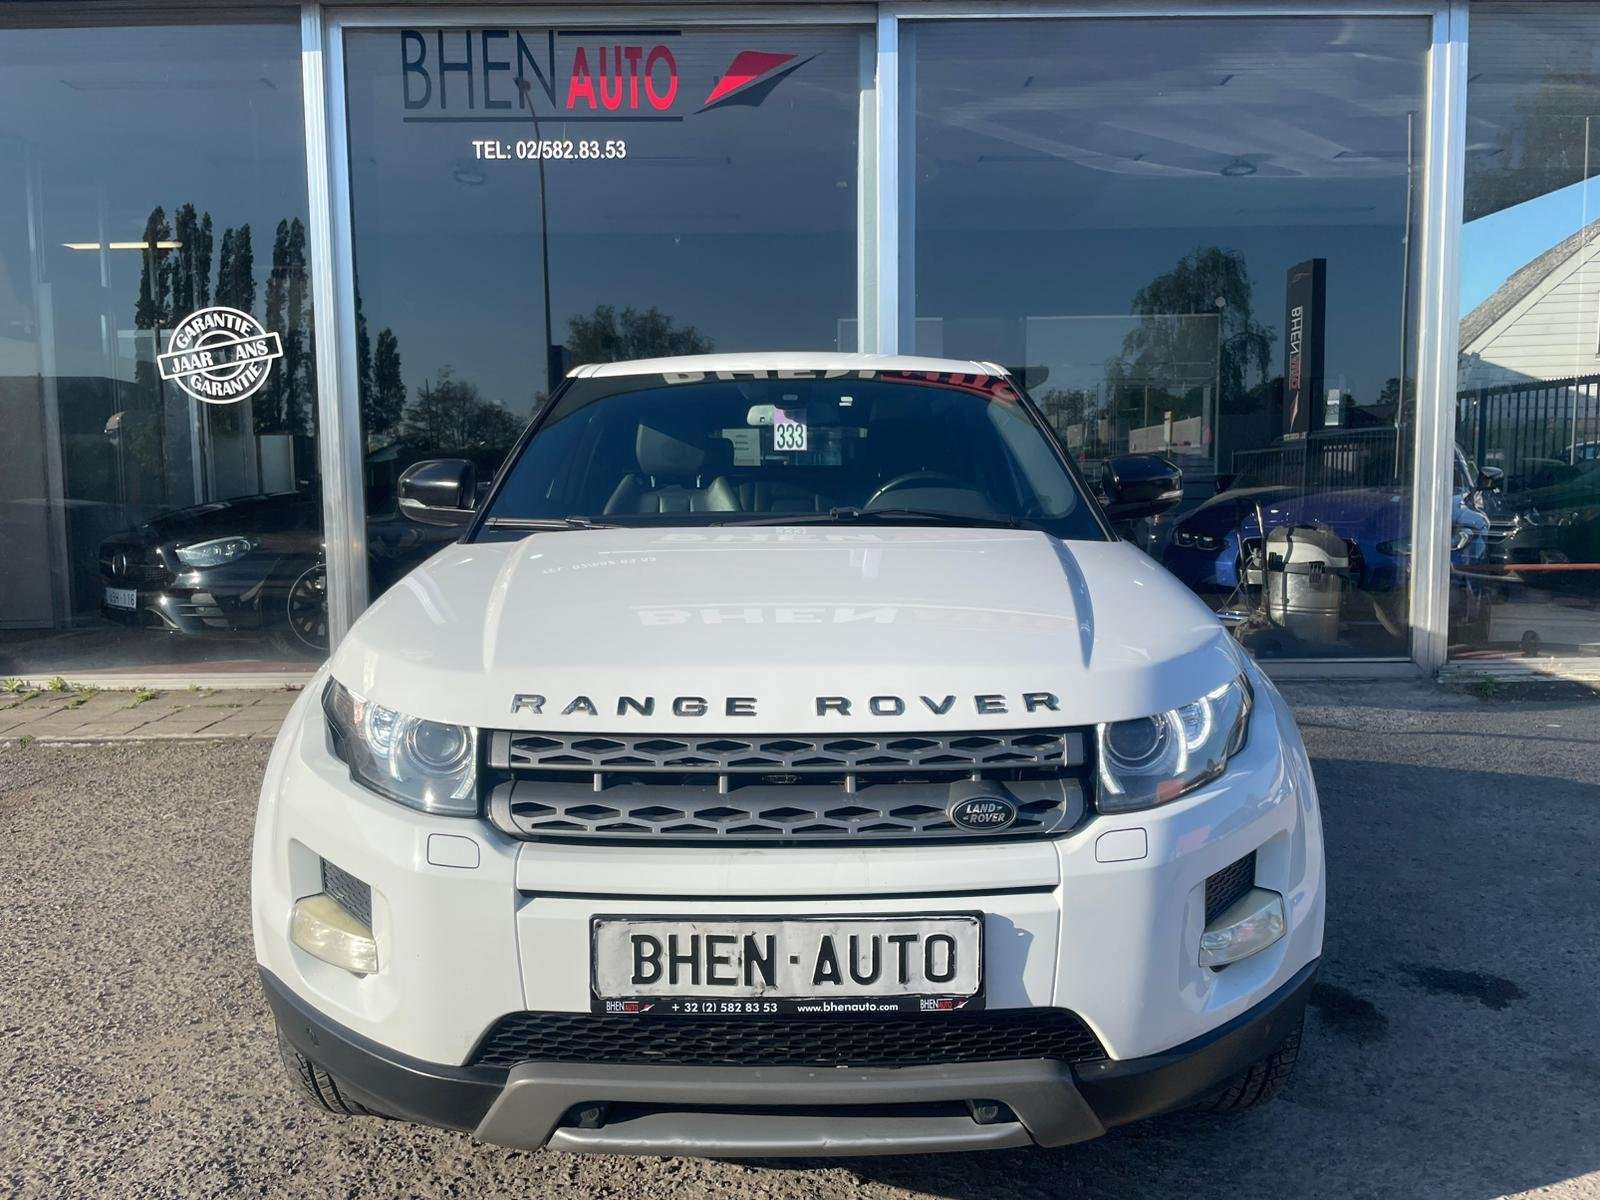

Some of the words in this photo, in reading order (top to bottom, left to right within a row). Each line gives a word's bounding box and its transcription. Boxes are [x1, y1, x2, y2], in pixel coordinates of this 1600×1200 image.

[401, 30, 557, 110] BHEN
[566, 45, 679, 111] AUTO
[472, 140, 512, 159] TEL:
[515, 140, 627, 159] 02/582.83.53
[176, 313, 253, 349] GARANTIE
[172, 351, 214, 374] JAAR
[235, 340, 269, 361] ANS
[190, 361, 263, 396] GARANTIE
[776, 423, 805, 449] 333
[510, 693, 758, 717] RANGE
[815, 691, 1062, 717] ROVER
[966, 803, 996, 814] LAND
[969, 813, 1005, 823] ROVER
[631, 933, 778, 986] BHEN
[811, 933, 957, 986] AUTO
[606, 1001, 625, 1012] BHEN
[684, 1003, 698, 1013] 32
[702, 1002, 717, 1013] (2)
[720, 1003, 743, 1013] 582
[745, 1003, 760, 1013] 83
[763, 1003, 778, 1013] 53
[797, 1002, 899, 1012] www.bhenauto.com
[920, 999, 938, 1009] BHEN
